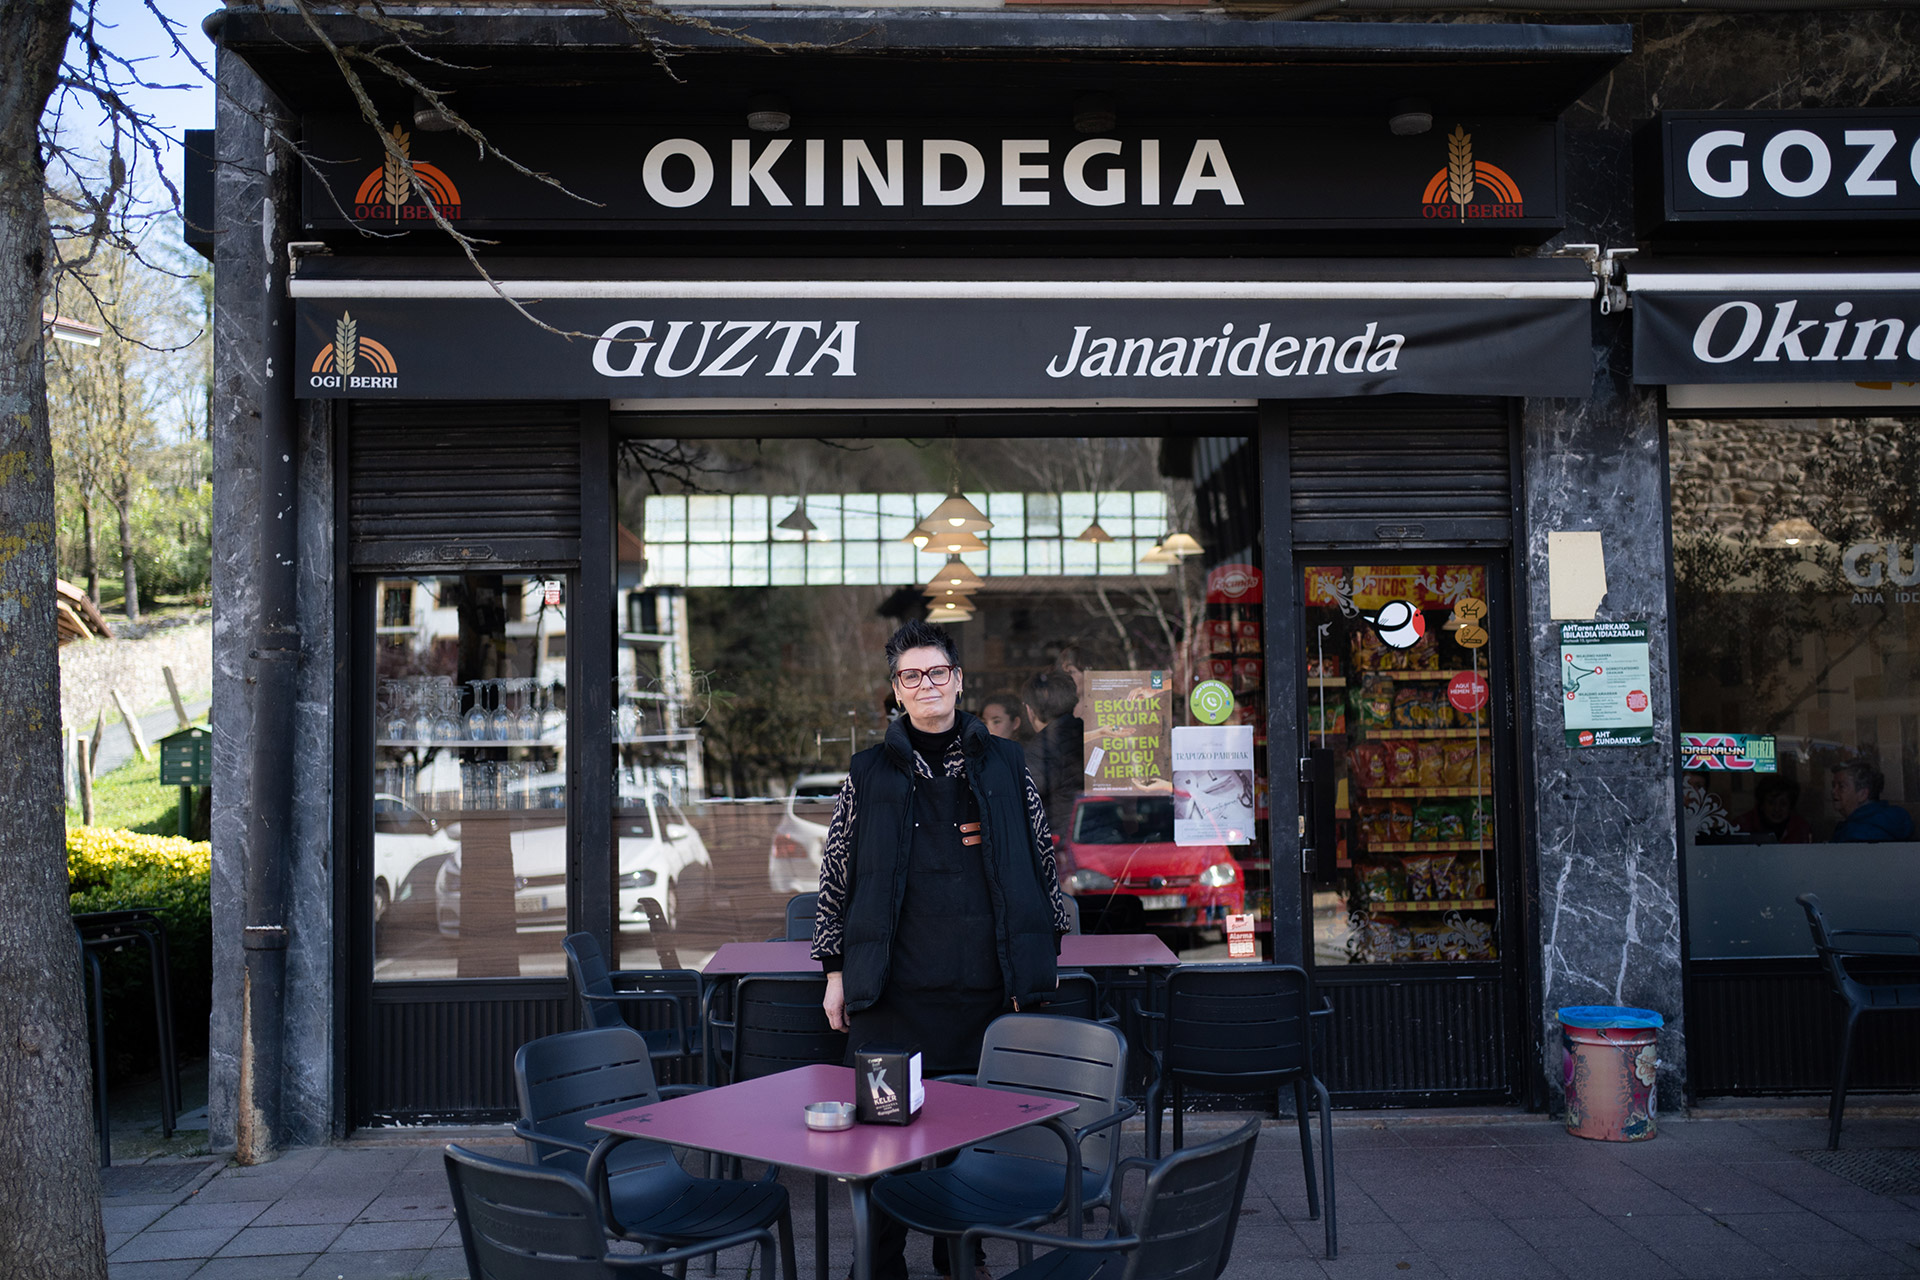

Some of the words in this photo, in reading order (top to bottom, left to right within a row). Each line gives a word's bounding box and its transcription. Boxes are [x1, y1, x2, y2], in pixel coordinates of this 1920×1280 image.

[1687, 129, 1920, 198] GOZ
[642, 137, 1245, 208] OKINDEGIA
[355, 204, 391, 220] OGI
[402, 204, 462, 220] BERRI
[1422, 204, 1457, 219] OGI
[1468, 204, 1524, 219] BERRI
[1692, 299, 1920, 364] Okin
[592, 319, 860, 378] GUZTA
[1046, 321, 1405, 379] Janaridenda
[310, 376, 341, 388] OGI
[350, 376, 398, 388] BERRI
[1594, 623, 1630, 631] AURKAKO
[1598, 630, 1645, 638] IDIAZABALEN
[1094, 696, 1162, 713] ESKUTIK
[1097, 711, 1160, 727] ESKURA
[1102, 736, 1160, 751] EGITEN
[1579, 734, 1593, 743] STOP
[1595, 736, 1642, 745] ZUNDAKETAK
[1109, 750, 1155, 765] DUGU
[1746, 740, 1775, 759] FUERZA
[1104, 763, 1161, 779] HERRIA
[873, 1095, 897, 1106] KELER
